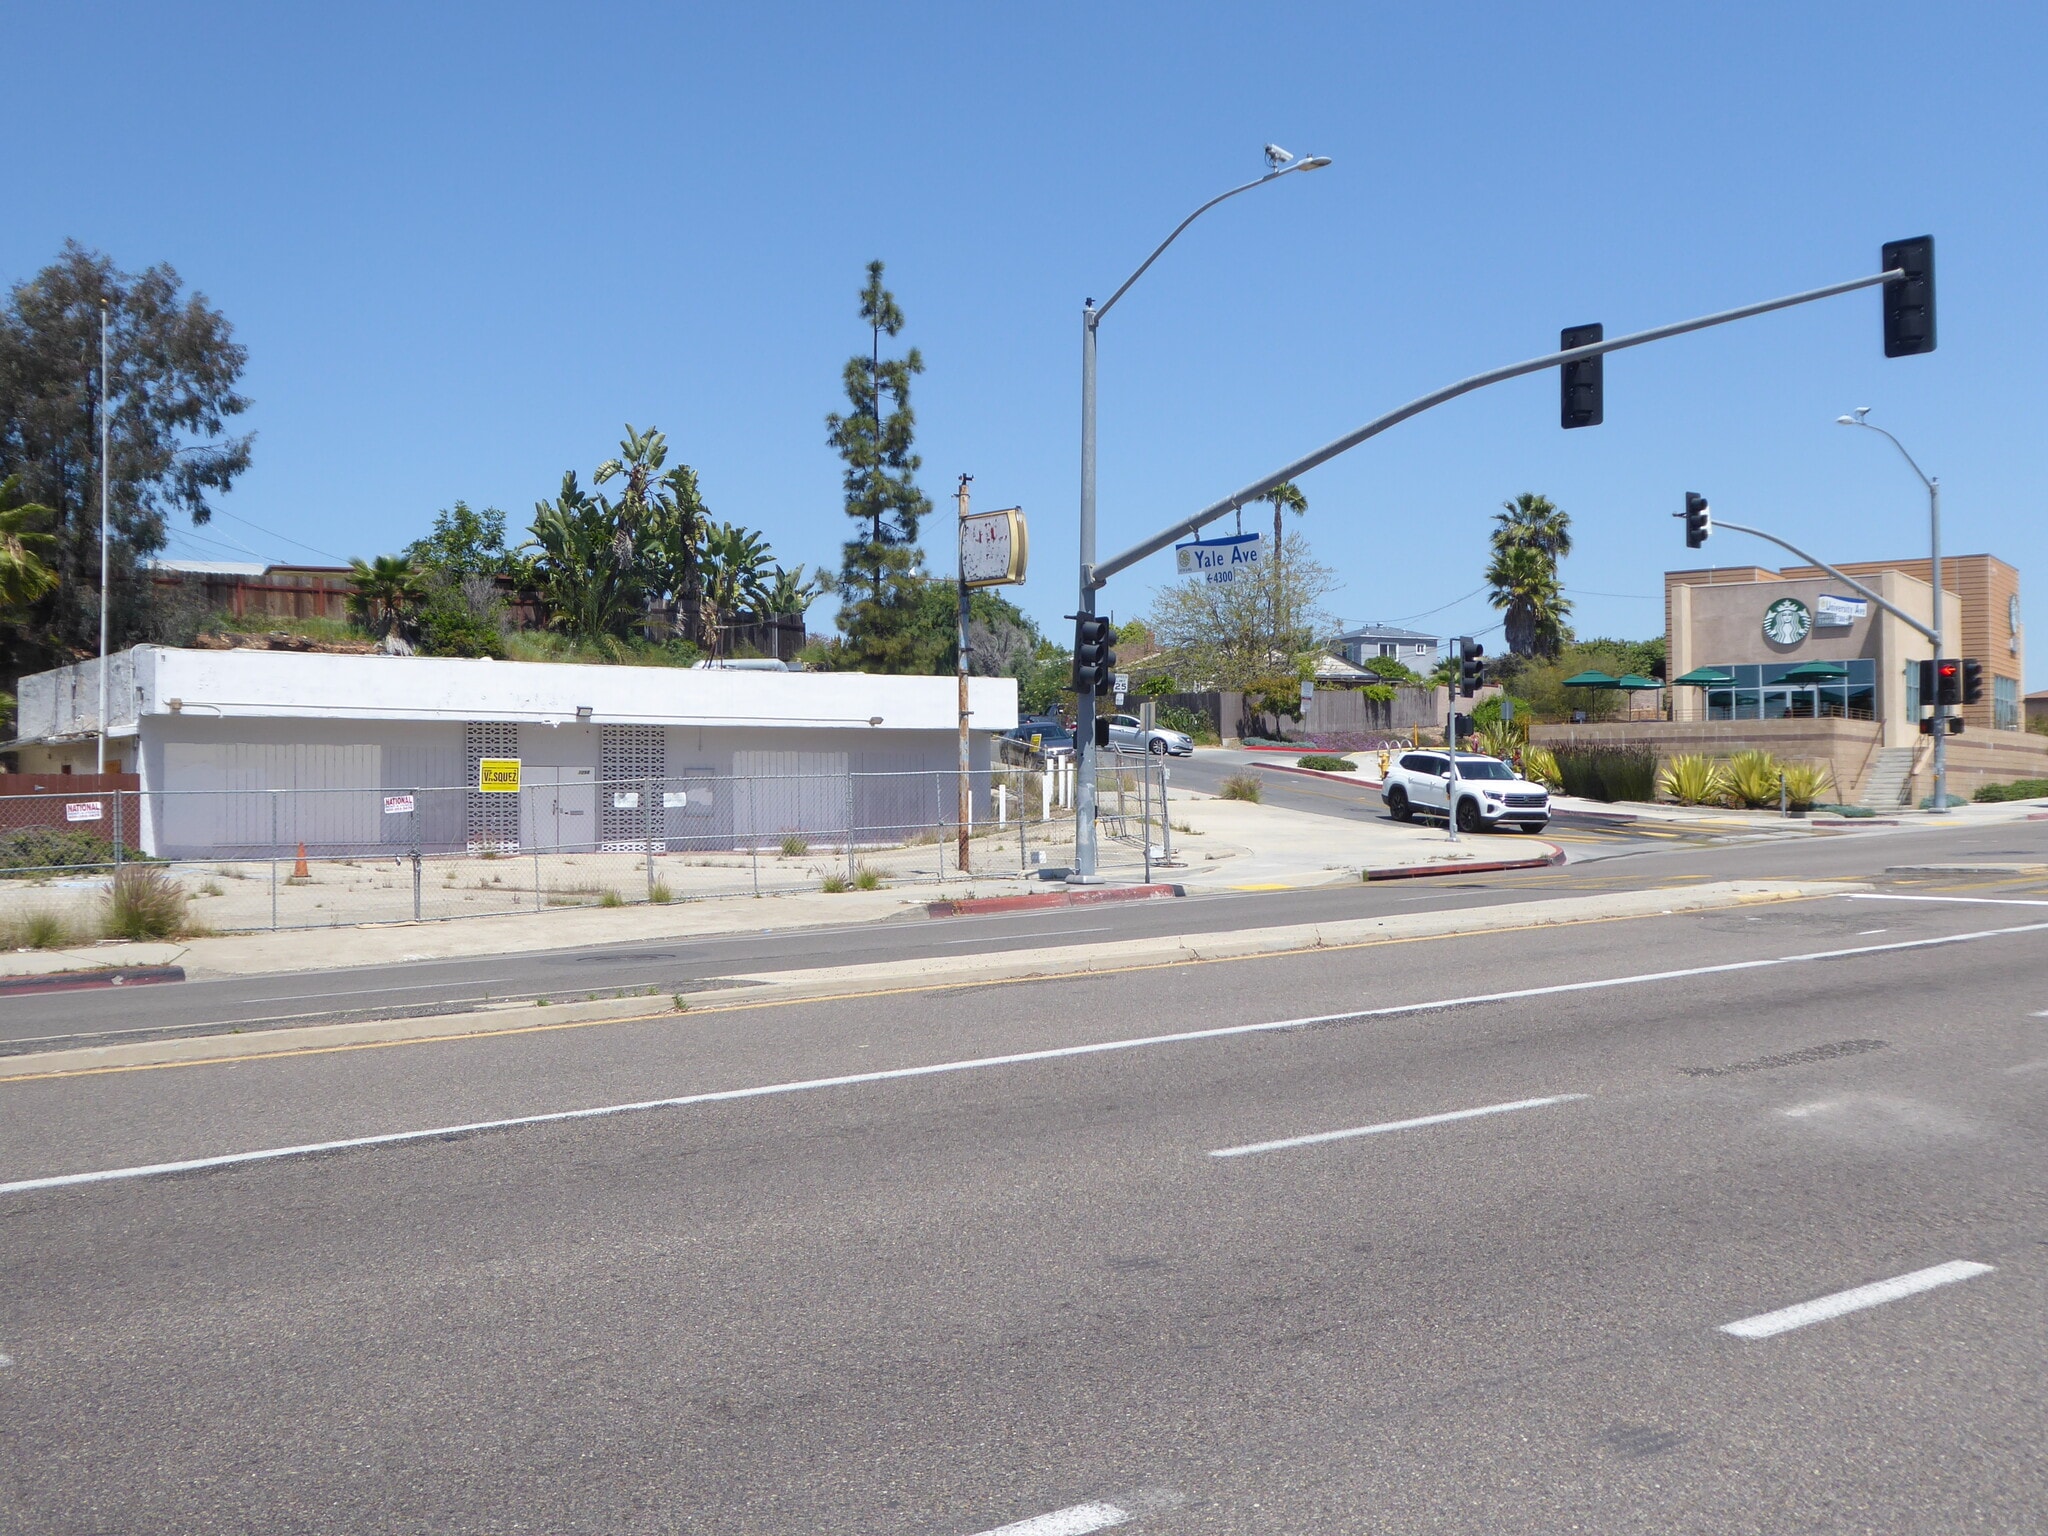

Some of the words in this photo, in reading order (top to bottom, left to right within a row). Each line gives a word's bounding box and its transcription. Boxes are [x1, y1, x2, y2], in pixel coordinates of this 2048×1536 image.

[1194, 550, 1224, 568] Yale
[1231, 545, 1257, 564] Ave
[1213, 570, 1233, 583] 4300
[1114, 682, 1127, 690] 25
[385, 796, 412, 806] NATIONAL
[67, 803, 100, 812] NATIONAL
